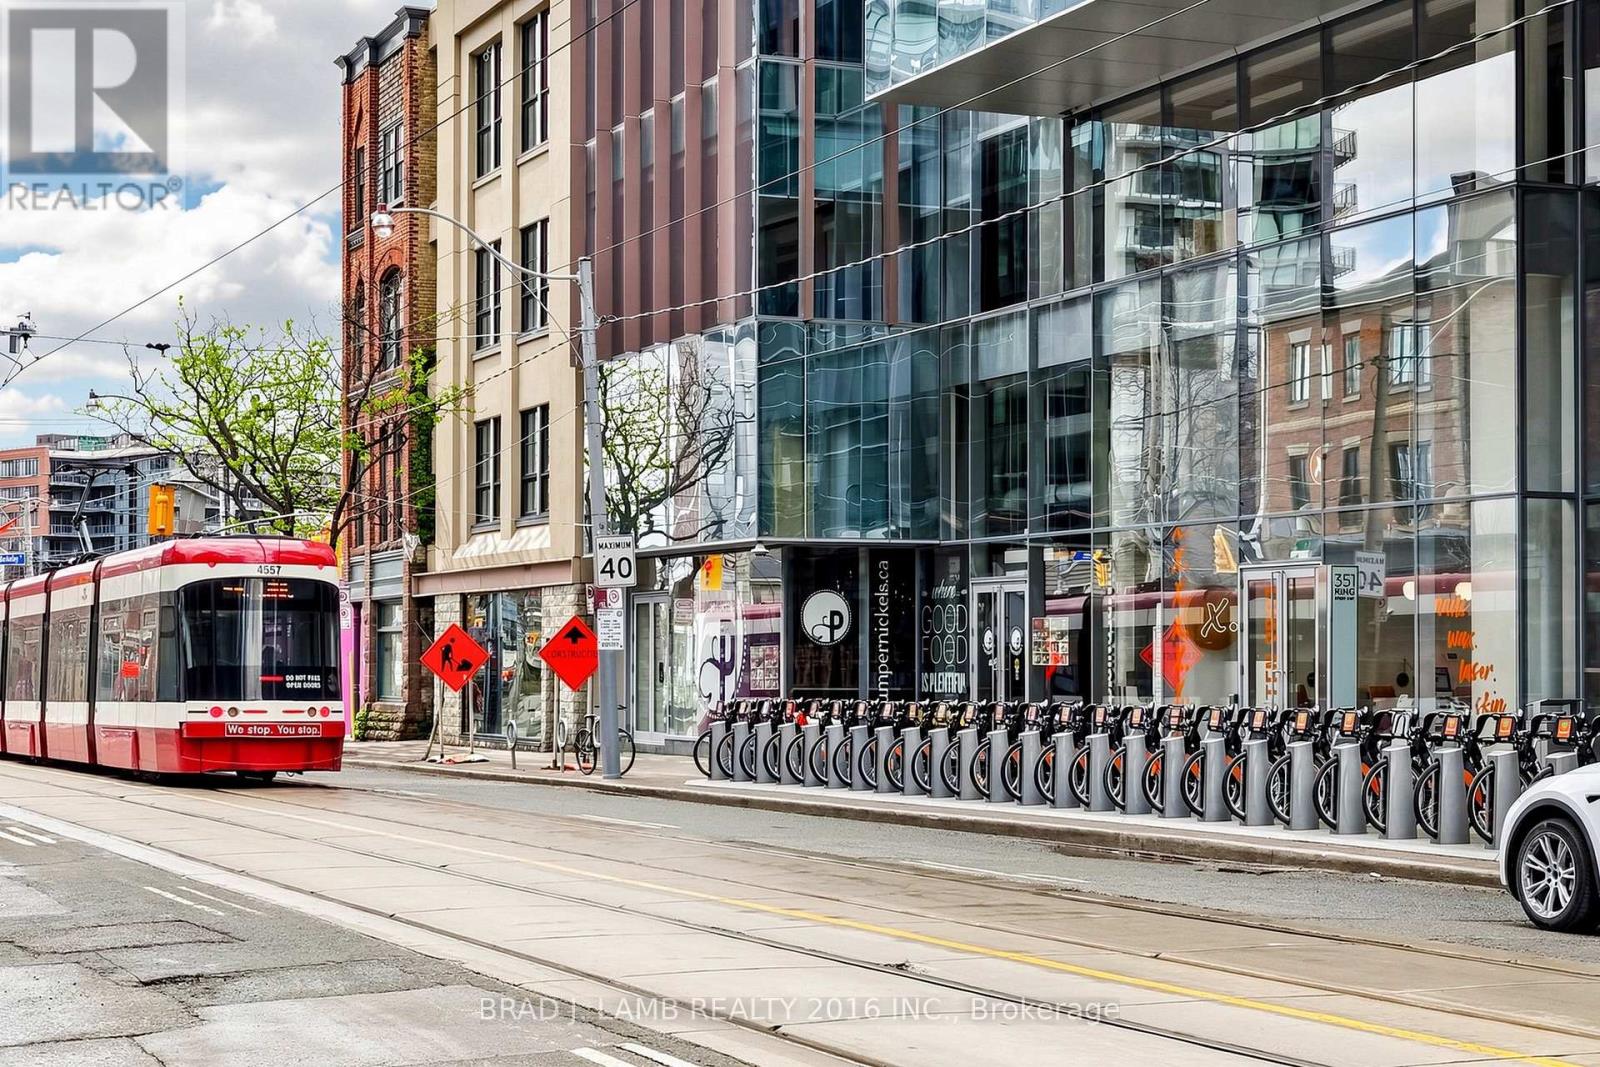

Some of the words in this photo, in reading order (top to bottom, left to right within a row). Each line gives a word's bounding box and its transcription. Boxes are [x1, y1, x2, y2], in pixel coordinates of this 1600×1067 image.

[598, 541, 631, 550] MAXIMUM
[257, 565, 282, 574] 4557
[600, 557, 632, 578] 40
[1334, 573, 1355, 587] 351
[921, 604, 968, 634] GOOD
[921, 635, 968, 664] FOOD
[921, 672, 929, 692] IS
[228, 725, 244, 734] We
[247, 725, 274, 736] stop.
[277, 725, 296, 734] You
[298, 725, 320, 735] stop.
